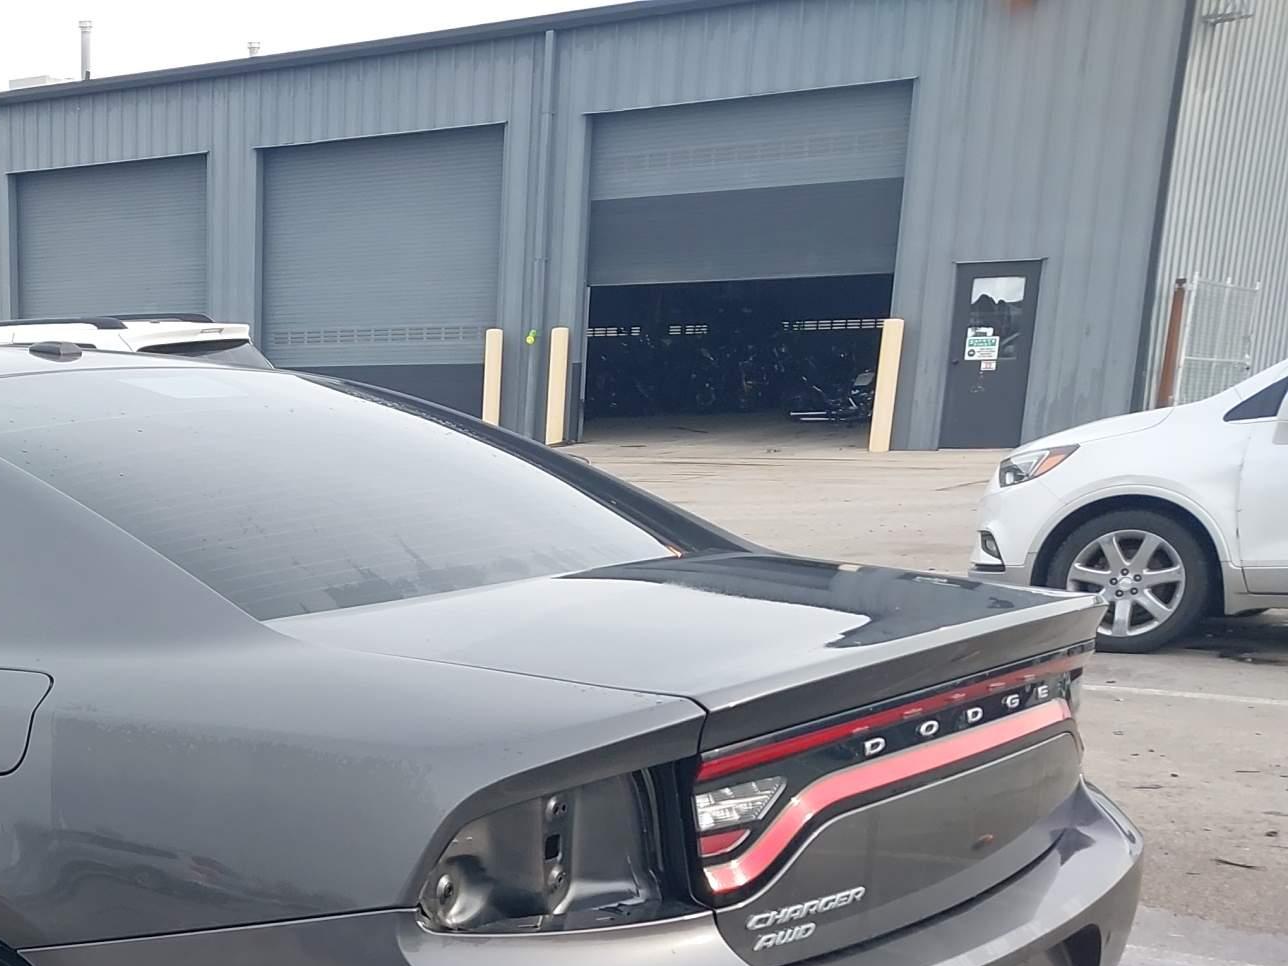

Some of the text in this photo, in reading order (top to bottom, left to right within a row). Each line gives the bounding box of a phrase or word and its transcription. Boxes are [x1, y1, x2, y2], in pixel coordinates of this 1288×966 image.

[863, 684, 1049, 757] DODGE
[746, 886, 866, 931] CHARGER
[752, 922, 816, 952] AWD
